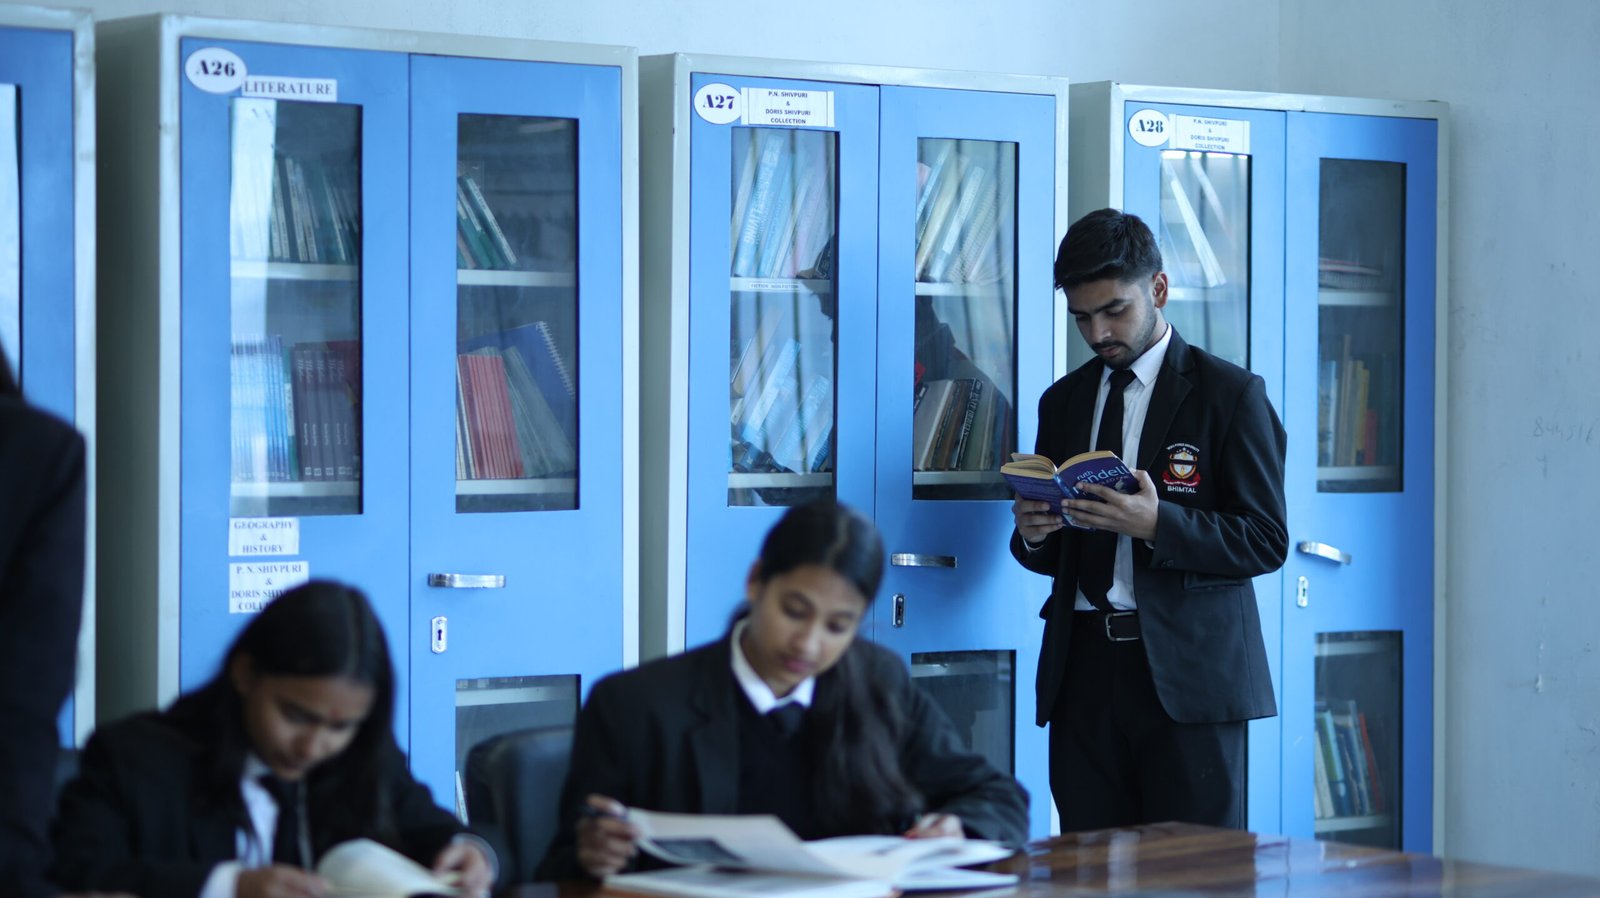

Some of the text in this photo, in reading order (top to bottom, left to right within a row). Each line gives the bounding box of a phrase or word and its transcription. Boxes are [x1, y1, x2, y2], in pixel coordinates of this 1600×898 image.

[195, 59, 236, 77] A26
[244, 80, 333, 95] LITERATURE
[702, 94, 735, 110] A27
[1135, 119, 1164, 133] A28
[1204, 119, 1228, 127] SHIVPURI
[1206, 135, 1230, 143] SHIVPURI
[1077, 470, 1093, 480] ruth
[1167, 485, 1197, 493] BHIMTAL
[234, 520, 293, 530] GEOGRAPHY
[242, 544, 283, 553] HISTORY
[258, 564, 302, 574] SHIVPURI
[231, 589, 287, 599] DORIS SHIV
